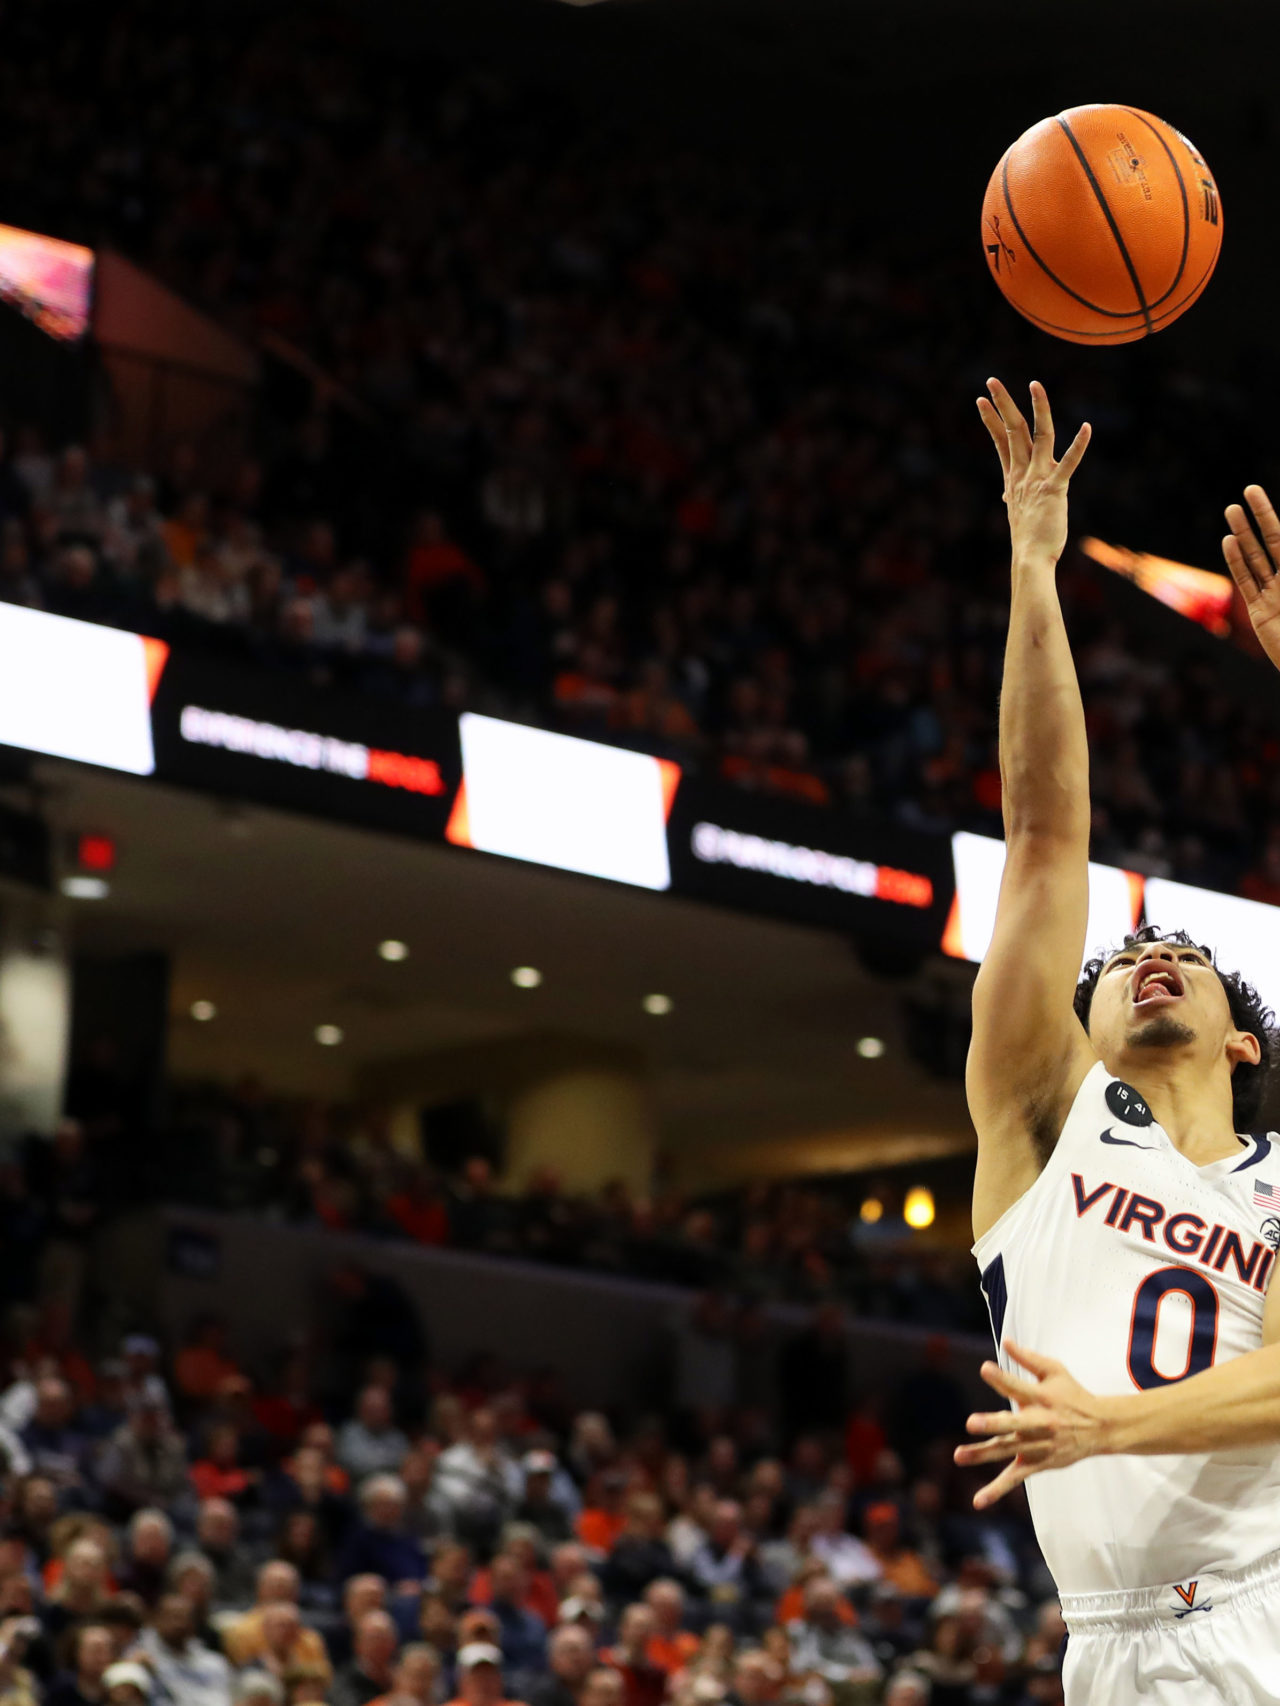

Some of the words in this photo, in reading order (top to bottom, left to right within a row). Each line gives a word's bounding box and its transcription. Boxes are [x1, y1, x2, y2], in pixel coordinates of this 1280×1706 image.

[1116, 1086, 1129, 1100] 15
[1134, 1102, 1146, 1115] 41
[1070, 1172, 1276, 1296] VIRGINI
[1126, 1264, 1219, 1392] 0
